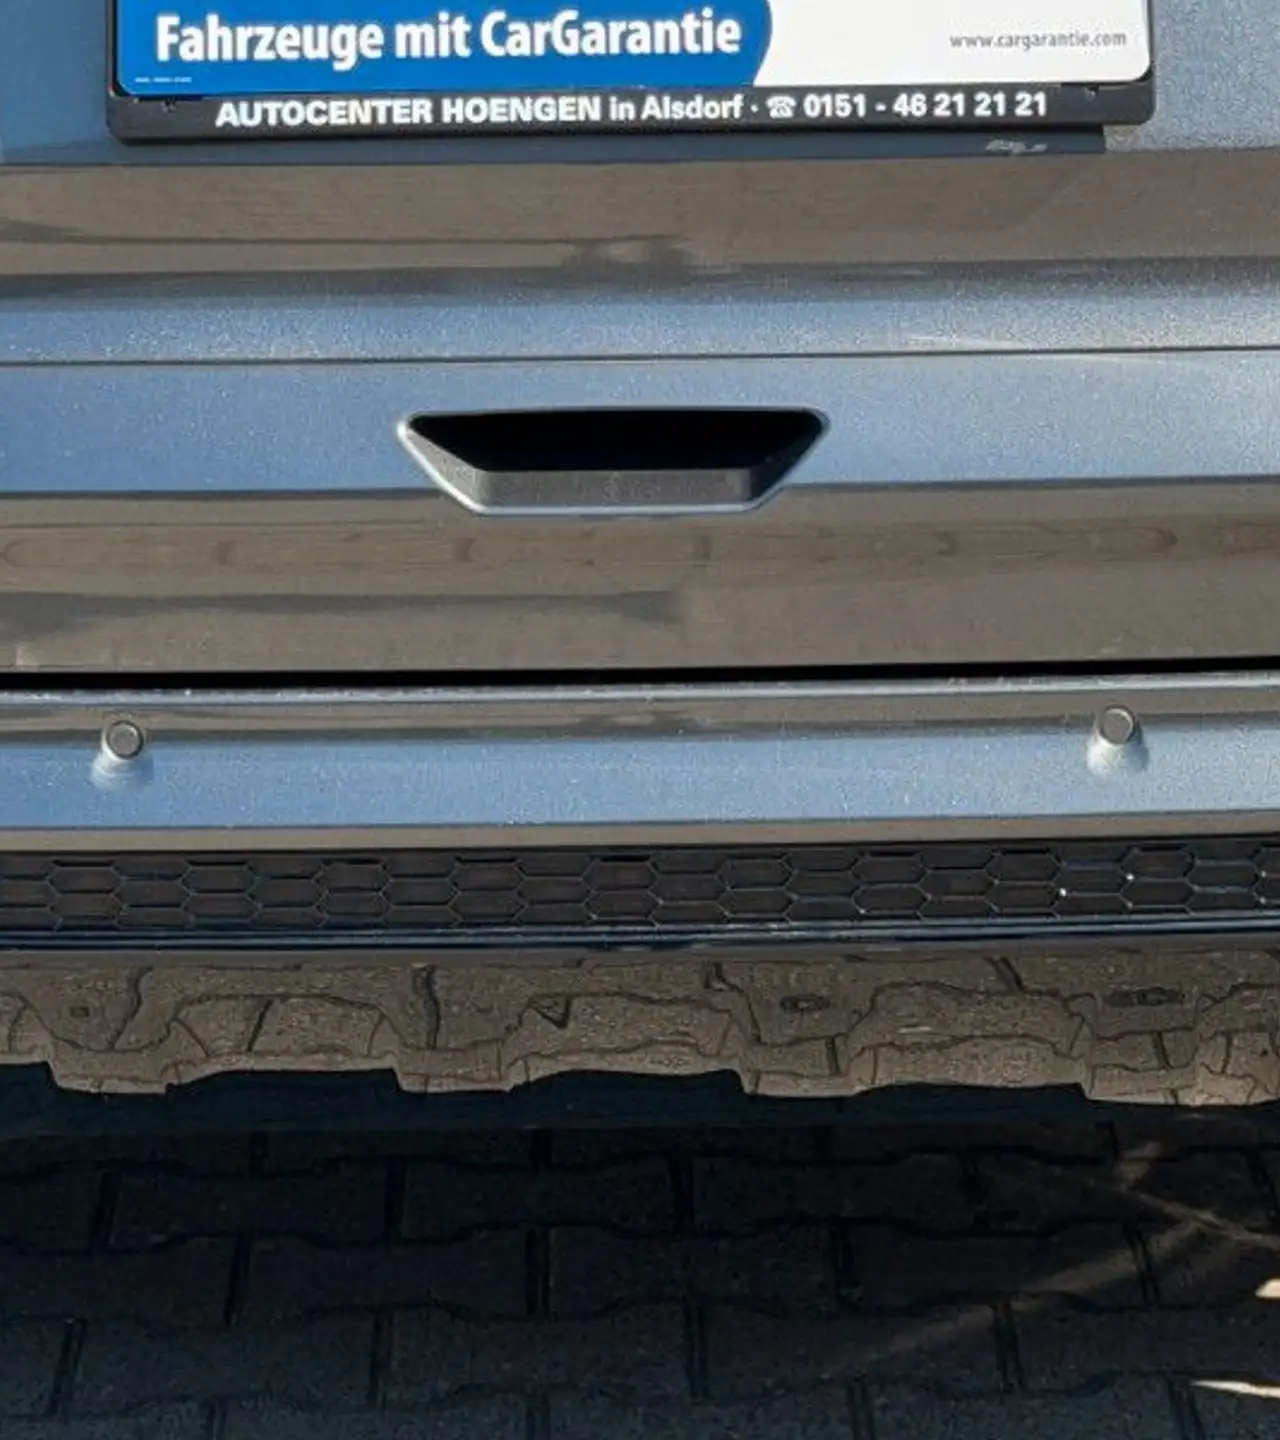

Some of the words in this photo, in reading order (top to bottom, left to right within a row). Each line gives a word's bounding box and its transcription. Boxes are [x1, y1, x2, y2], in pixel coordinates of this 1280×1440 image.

[154, 12, 384, 72] Fahrzeuge
[394, 10, 472, 59] mit
[480, 6, 743, 58] CarGarantie
[949, 31, 1128, 51] www.cargarantie.com
[214, 97, 434, 128] AUTOCENTER
[440, 96, 601, 124] HOENGEN
[608, 96, 636, 122] in
[639, 94, 744, 121] Alsdorf
[803, 92, 867, 118] 0151
[892, 91, 928, 118] 46
[932, 91, 966, 117] 21
[973, 91, 1007, 117] 21
[1014, 90, 1047, 117] 21
